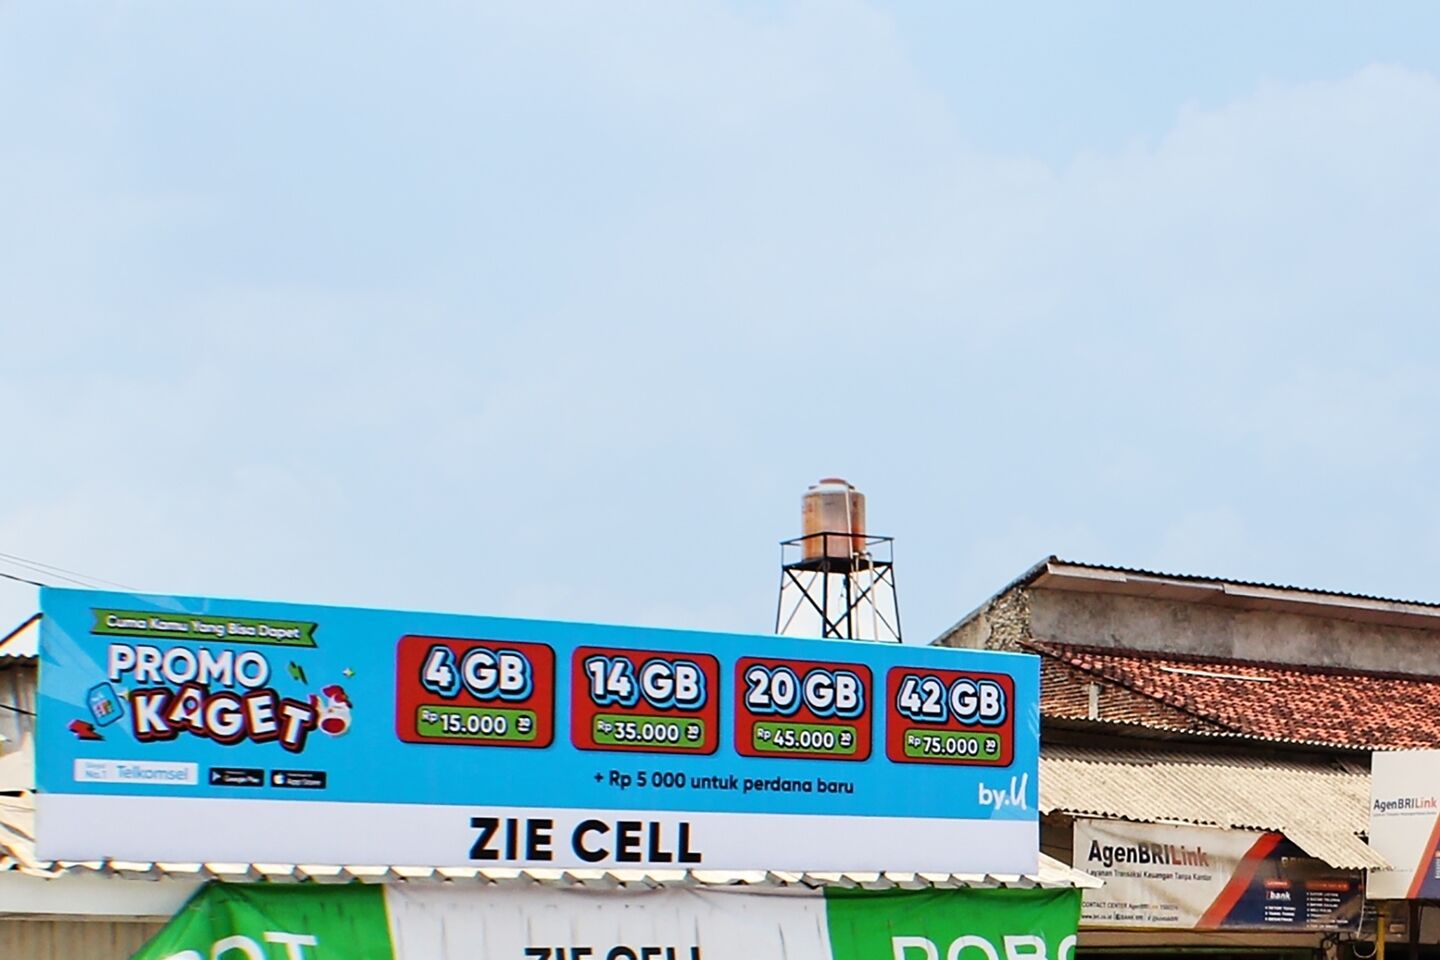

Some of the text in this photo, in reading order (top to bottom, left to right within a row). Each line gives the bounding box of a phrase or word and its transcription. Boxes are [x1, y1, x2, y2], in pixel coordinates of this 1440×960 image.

[106, 615, 301, 640] Cuma Kamu Yang Bisa Dapet
[108, 643, 269, 687] PROMO
[426, 649, 523, 691] 4 GB
[589, 660, 700, 700] 14 GB
[748, 669, 858, 709] 20 GB
[899, 679, 1000, 717] 42 GB
[133, 685, 315, 746] KAGET
[422, 709, 439, 724] Rp
[441, 714, 507, 734] 15.000
[597, 720, 614, 735] Rp
[615, 722, 679, 742] 35.000
[757, 729, 771, 741] Rp
[774, 730, 834, 749] 45.000
[907, 735, 921, 747] Rp
[923, 737, 978, 755] 75.000
[116, 764, 189, 781] Telkomsel
[609, 770, 631, 790] Rp
[637, 772, 647, 786] 5
[652, 772, 686, 788] 000
[690, 773, 740, 792] untuk
[743, 776, 814, 797] perdana
[817, 778, 855, 796] baru
[1373, 796, 1438, 813] AgenBRILink
[469, 816, 703, 864] ZIE CELL
[1088, 839, 1210, 868] AgenBRILink
